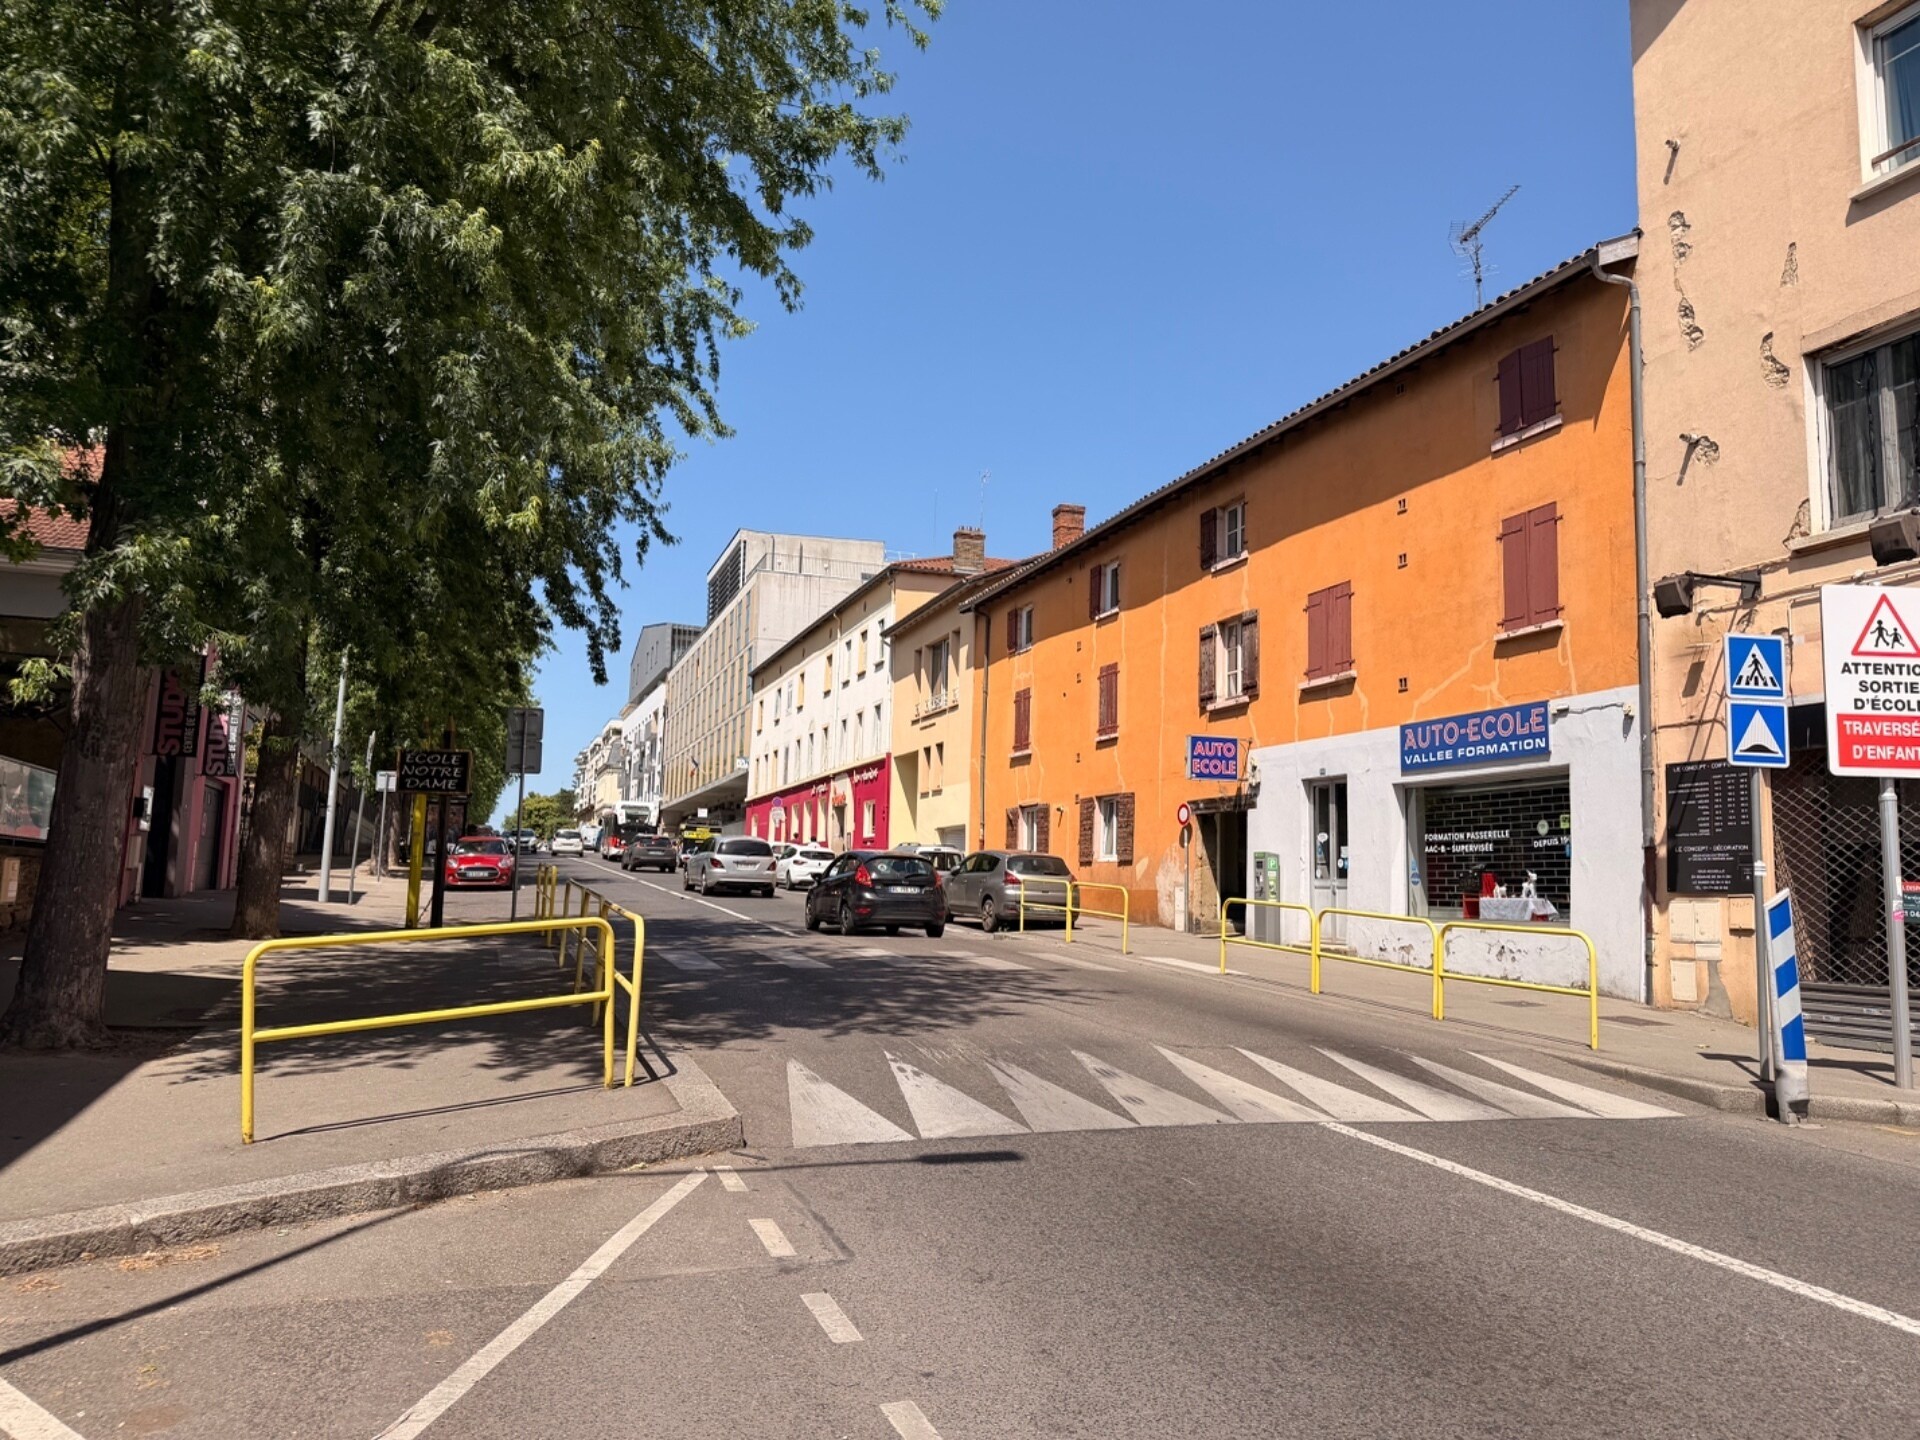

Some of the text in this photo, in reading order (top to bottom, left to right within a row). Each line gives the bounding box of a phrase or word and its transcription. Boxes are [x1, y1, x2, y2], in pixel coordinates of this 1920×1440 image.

[1858, 680, 1920, 694] SORTIE
[1853, 695, 1920, 712] D'ÉCOL
[1404, 707, 1546, 750] AUTO-ECOLE
[1193, 740, 1236, 758] AUTO
[1404, 737, 1546, 765] VALLEE FORMATION
[401, 765, 462, 778] NOTRE
[1192, 758, 1236, 775] ECOLE
[405, 777, 458, 790] DAME
[1424, 829, 1511, 842] FORMATION PASSERELLE
[1451, 842, 1494, 853] SUPERVISÉE
[1533, 838, 1559, 848] DEPUIS
